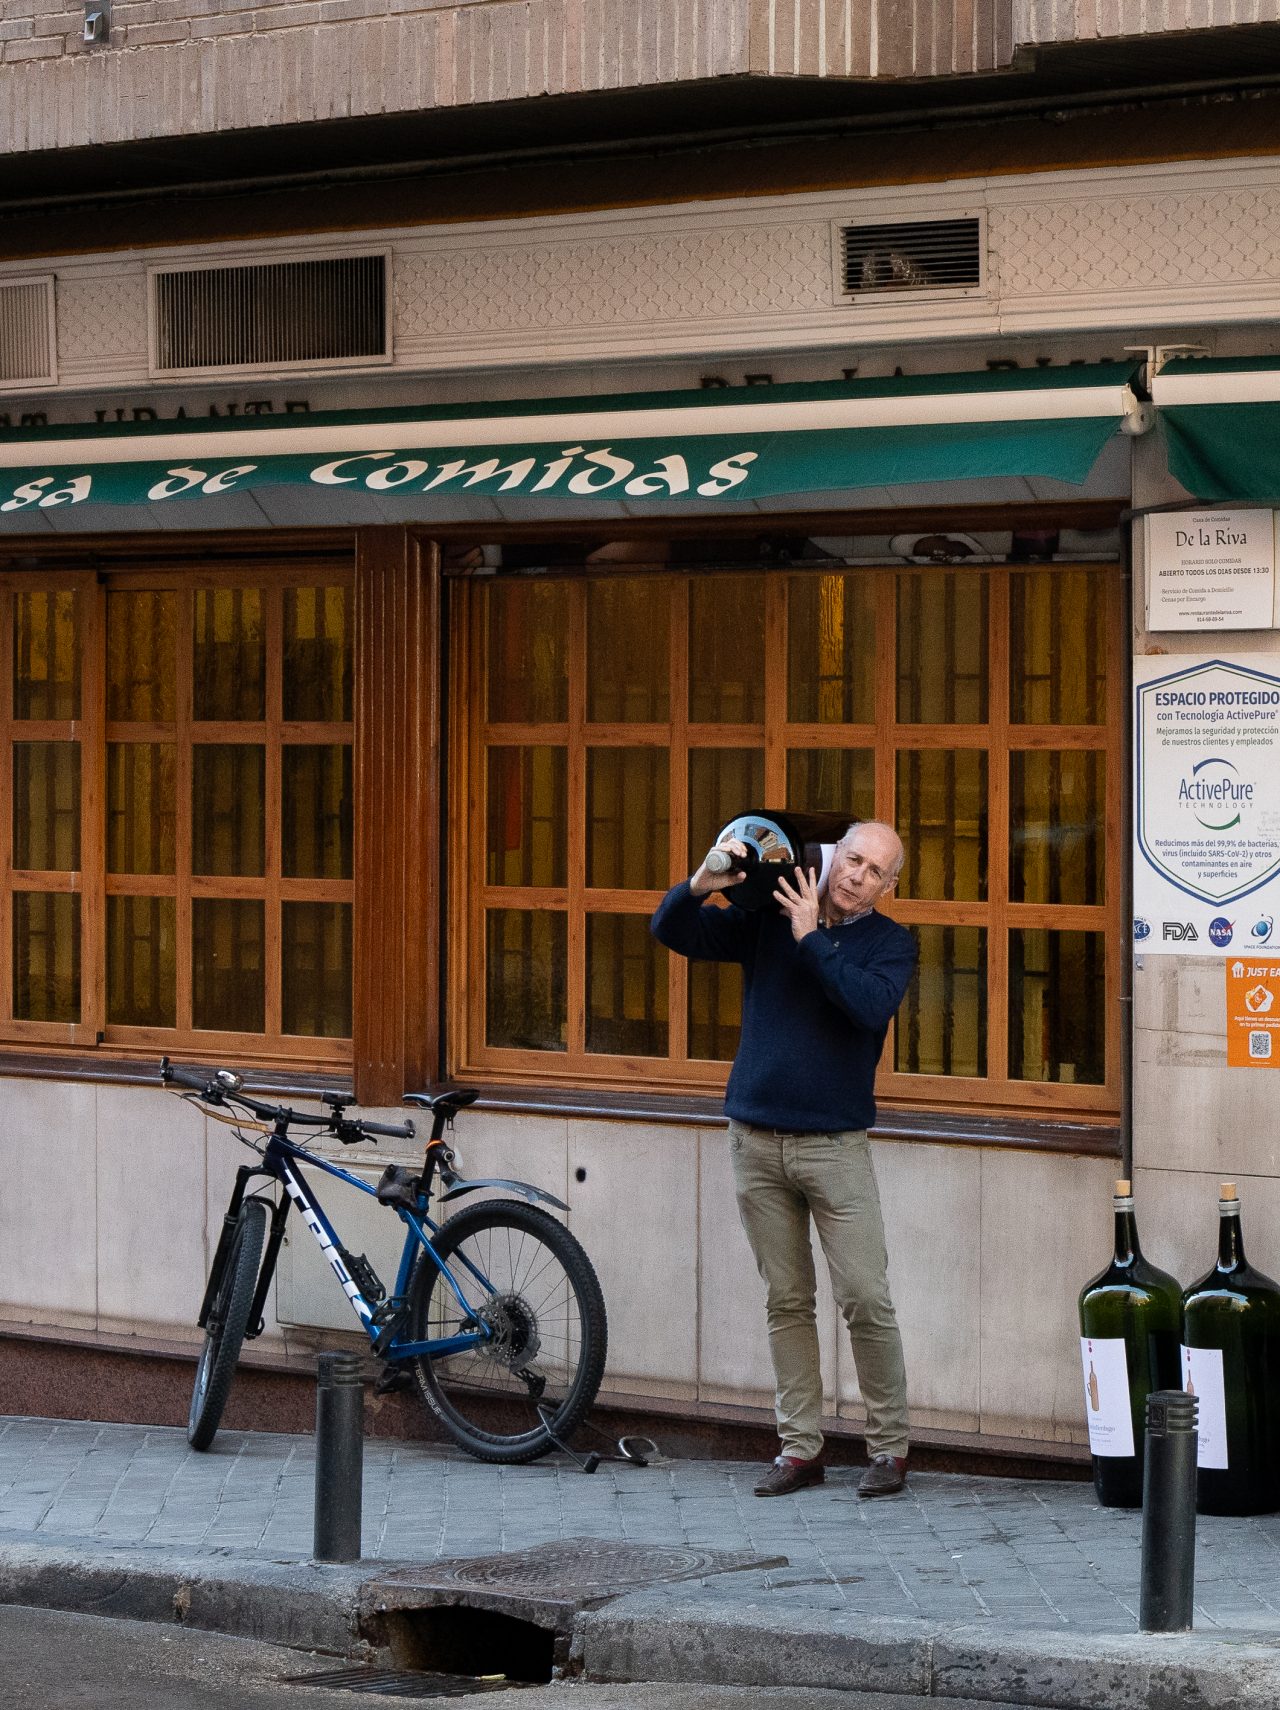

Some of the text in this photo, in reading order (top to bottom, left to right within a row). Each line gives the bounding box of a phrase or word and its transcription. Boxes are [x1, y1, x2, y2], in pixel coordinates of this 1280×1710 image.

[147, 465, 258, 501] de
[310, 445, 759, 497] Comidas
[1176, 527, 1247, 546] De la Riva
[1155, 691, 1280, 706] ESPACIO PROTEGIDO
[1156, 712, 1173, 721] con
[1175, 709, 1224, 723] Tecnología
[1156, 726, 1279, 737] Mejoramos la seguridad y protección
[1161, 737, 1274, 747] de nuestros clientes y empleados
[1155, 839, 1190, 847] Reducimos
[1205, 839, 1216, 847] del
[1217, 839, 1236, 848] 99,9%
[1237, 839, 1246, 847] de
[1162, 849, 1178, 857] virus
[1208, 850, 1248, 858] SARS-CoV-2)
[1249, 851, 1254, 859] y
[1255, 850, 1272, 858] otros
[1181, 860, 1229, 868] contaminantes
[1239, 860, 1253, 868] aire
[1203, 870, 1238, 879] superficies
[1162, 921, 1199, 941] FDA
[1210, 928, 1232, 937] NASA
[1246, 967, 1268, 977] JUST
[284, 1168, 374, 1324] TREK
